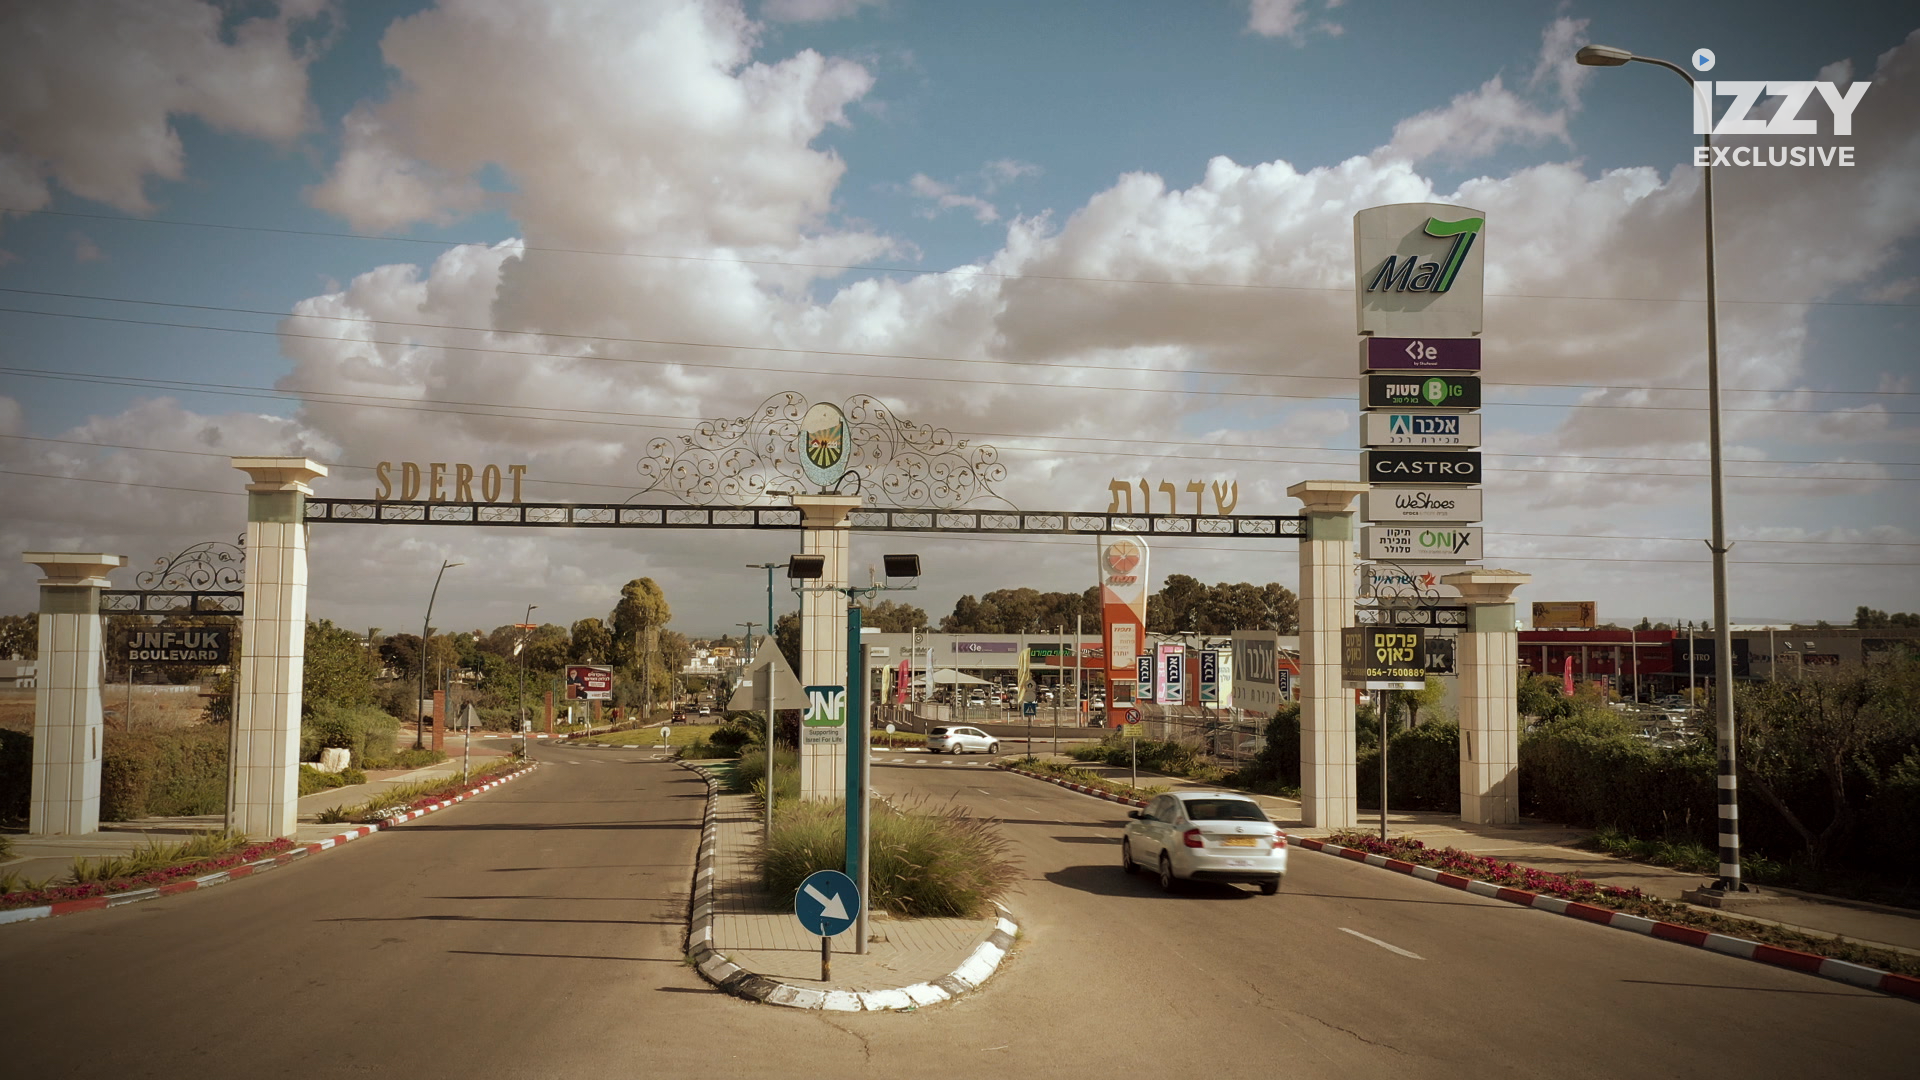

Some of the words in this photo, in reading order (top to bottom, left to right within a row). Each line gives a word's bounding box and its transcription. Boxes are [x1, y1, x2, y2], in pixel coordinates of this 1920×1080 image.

[1386, 384, 1420, 398] סטוק
[1427, 381, 1463, 400] BIG
[1415, 417, 1456, 433] אלבר
[1420, 436, 1460, 444] מכירת
[1375, 460, 1474, 475] CASTRO
[375, 461, 527, 503] SDEROT
[1107, 477, 1238, 516] שדרות
[1395, 491, 1455, 509] WeShoes
[1379, 537, 1411, 545] ומכירת
[1387, 529, 1411, 537] תיקון
[1384, 545, 1411, 554] סלולר
[128, 632, 220, 649] JNF-UK
[1374, 633, 1417, 648] פרסם
[129, 650, 218, 660] BOULEVARD
[1247, 644, 1273, 680] אלבר
[1387, 648, 1414, 665] כאן
[1140, 659, 1149, 682] אלבר
[1168, 657, 1178, 682] אלבר
[1203, 654, 1214, 681] אלבר
[1366, 668, 1425, 677] 054-7500889
[804, 690, 845, 721] JNF
